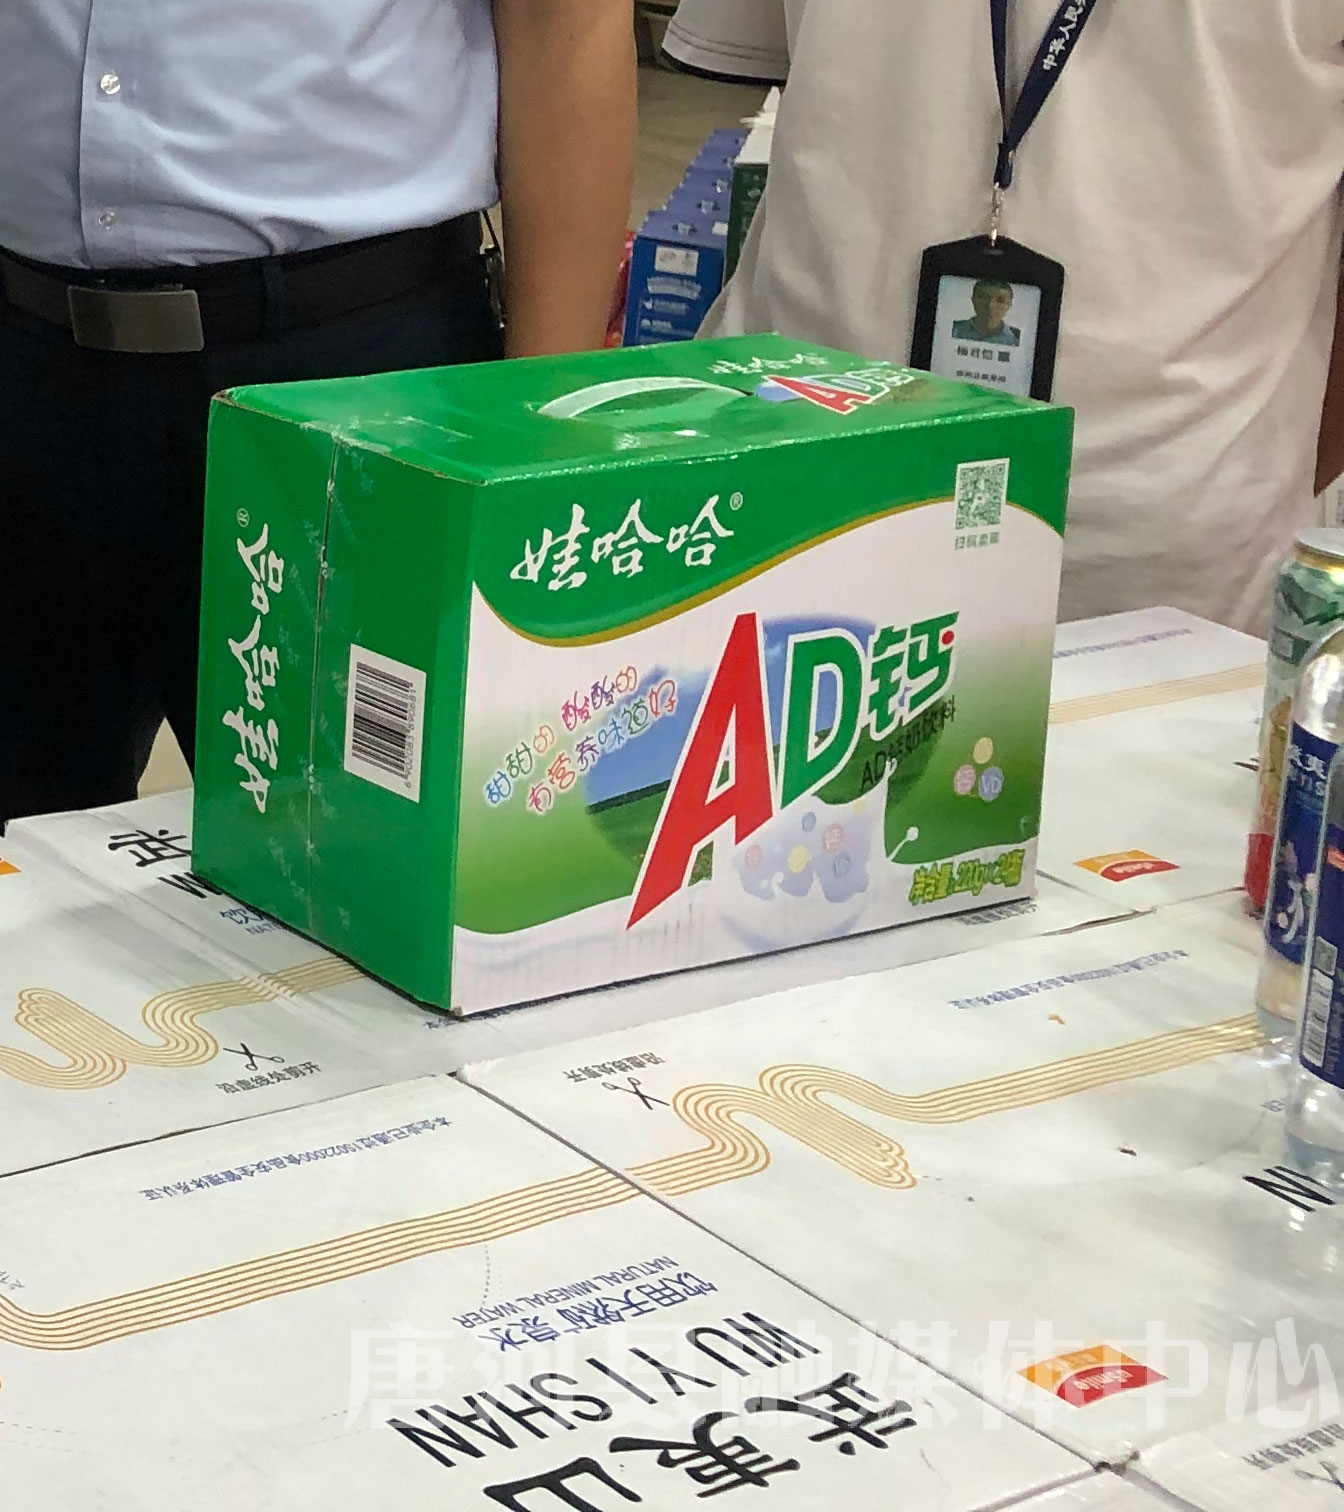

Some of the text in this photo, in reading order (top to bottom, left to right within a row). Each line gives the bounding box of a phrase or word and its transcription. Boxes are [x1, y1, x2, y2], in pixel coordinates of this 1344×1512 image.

[528, 679, 678, 813] 有营养味道好
[452, 1255, 680, 1329] NATURAL MINERAL WATER
[385, 1311, 822, 1469] WU YI SHAN
